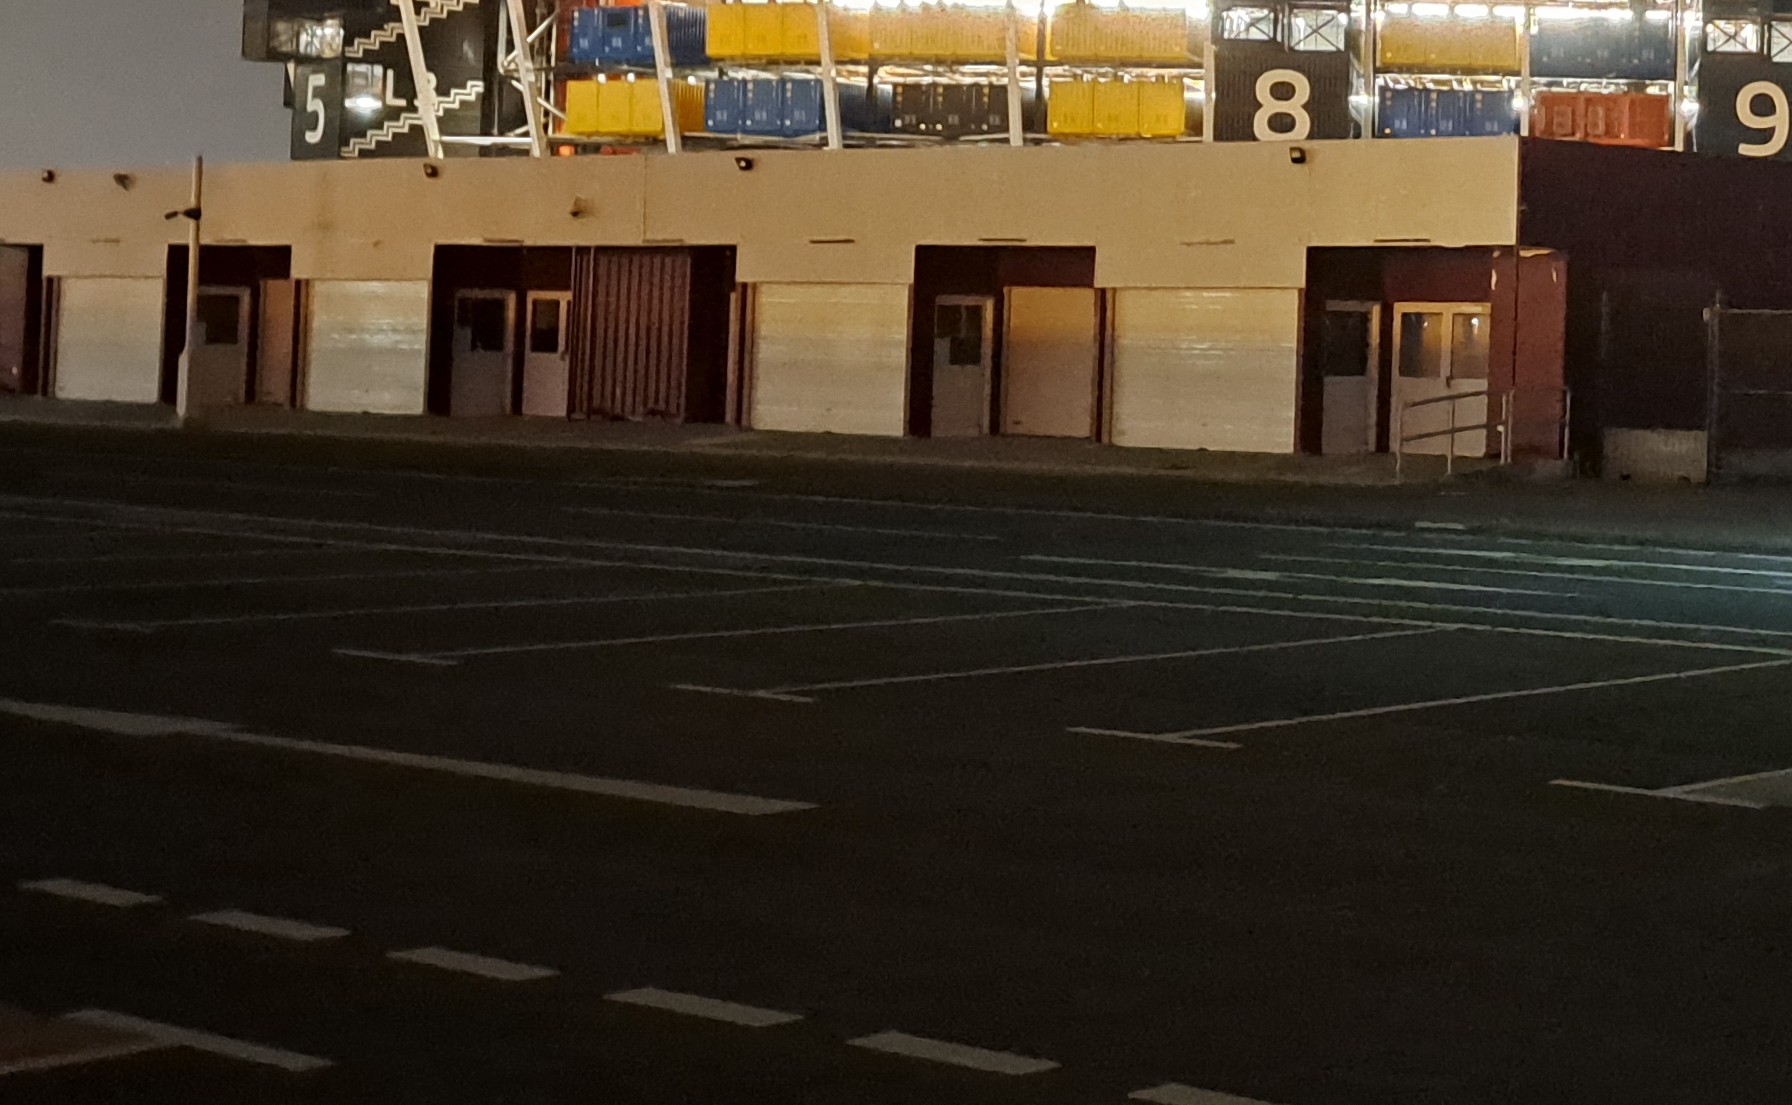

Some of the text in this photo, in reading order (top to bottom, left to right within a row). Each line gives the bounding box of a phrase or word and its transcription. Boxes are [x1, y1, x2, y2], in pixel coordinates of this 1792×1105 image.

[304, 73, 326, 144] 5
[1253, 68, 1311, 142] 8
[1735, 80, 1790, 157] 9
